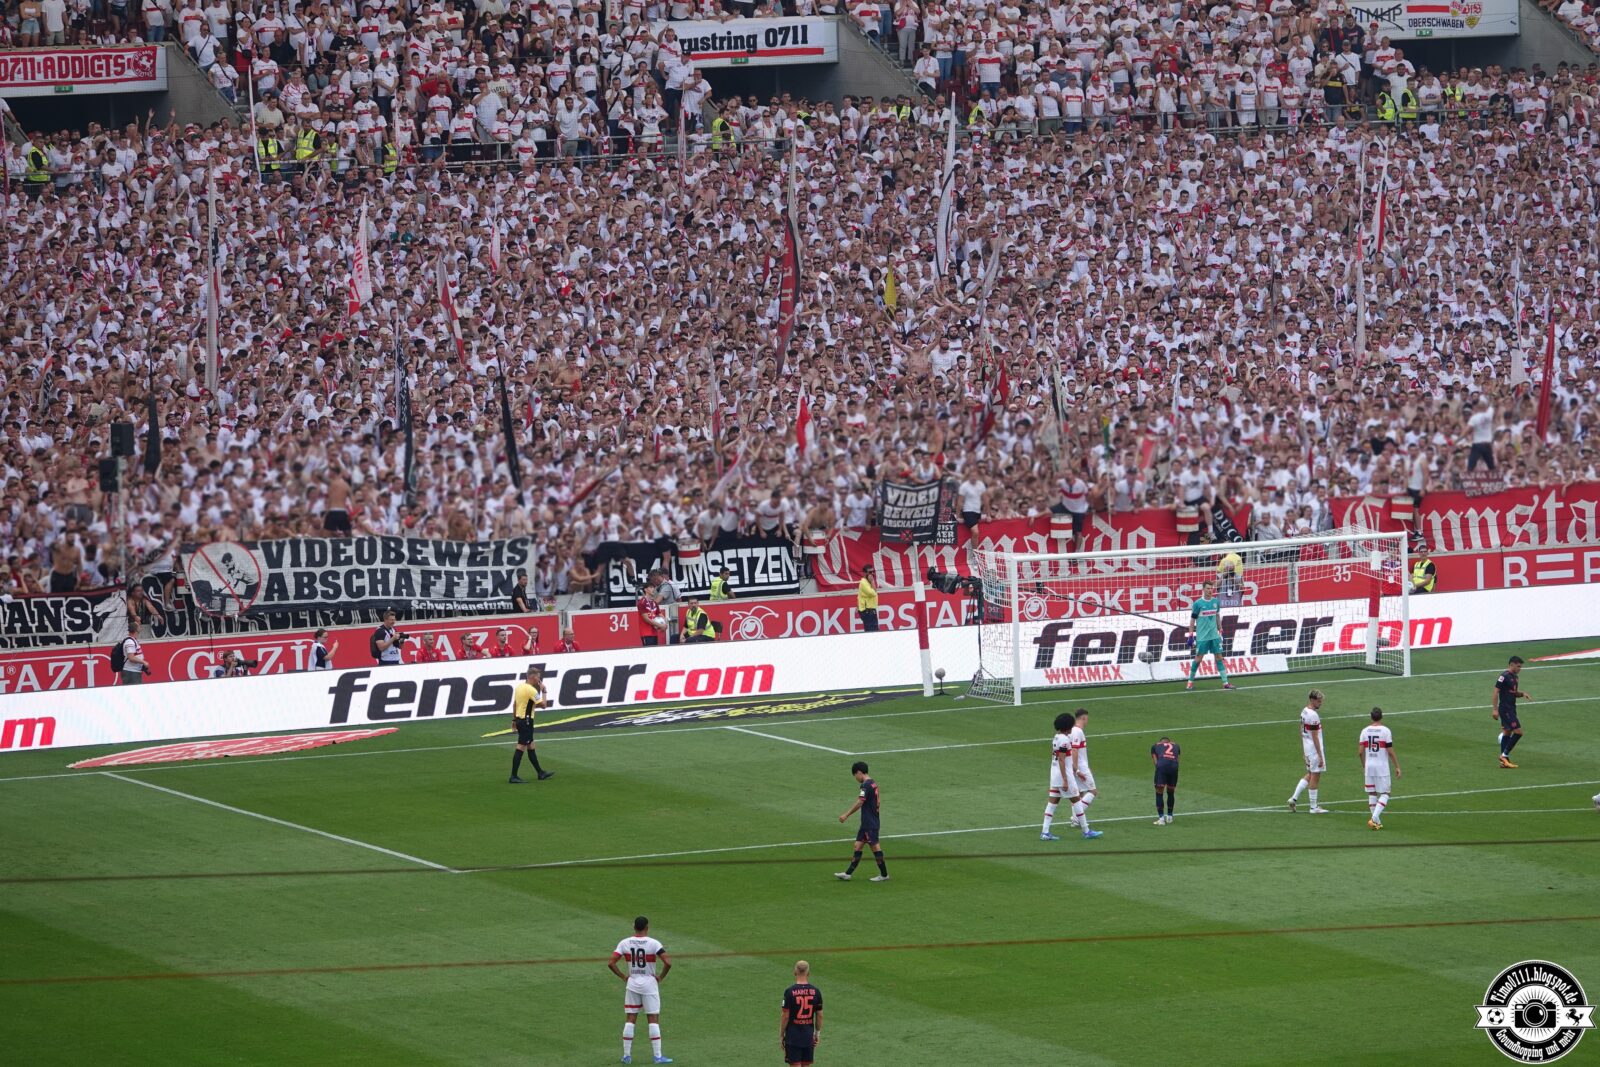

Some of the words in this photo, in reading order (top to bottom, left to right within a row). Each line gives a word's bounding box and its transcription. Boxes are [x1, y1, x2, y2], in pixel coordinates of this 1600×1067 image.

[1408, 17, 1464, 28] OBERSCHWABEN
[674, 31, 757, 53] rustring
[765, 25, 808, 48] 0711
[886, 486, 940, 507] VIDEO
[883, 504, 936, 519] BEWEIS
[1342, 489, 1600, 558] Cnnsta
[261, 537, 529, 569] VIDEOBEWEIS
[671, 546, 798, 589] UMSETZEN
[1333, 564, 1351, 582] 35
[410, 599, 514, 611] Schwabensturm
[1060, 581, 1258, 619] JOKERSR
[0, 597, 91, 633] ANS
[609, 614, 629, 632] 34
[1033, 615, 1452, 669] fenster.com
[1045, 664, 1124, 684] WINAMAX
[328, 663, 775, 725] fenster.com
[1164, 743, 1174, 755] 2
[1368, 736, 1379, 752] 15
[630, 948, 646, 968] 18
[796, 996, 814, 1019] 25
